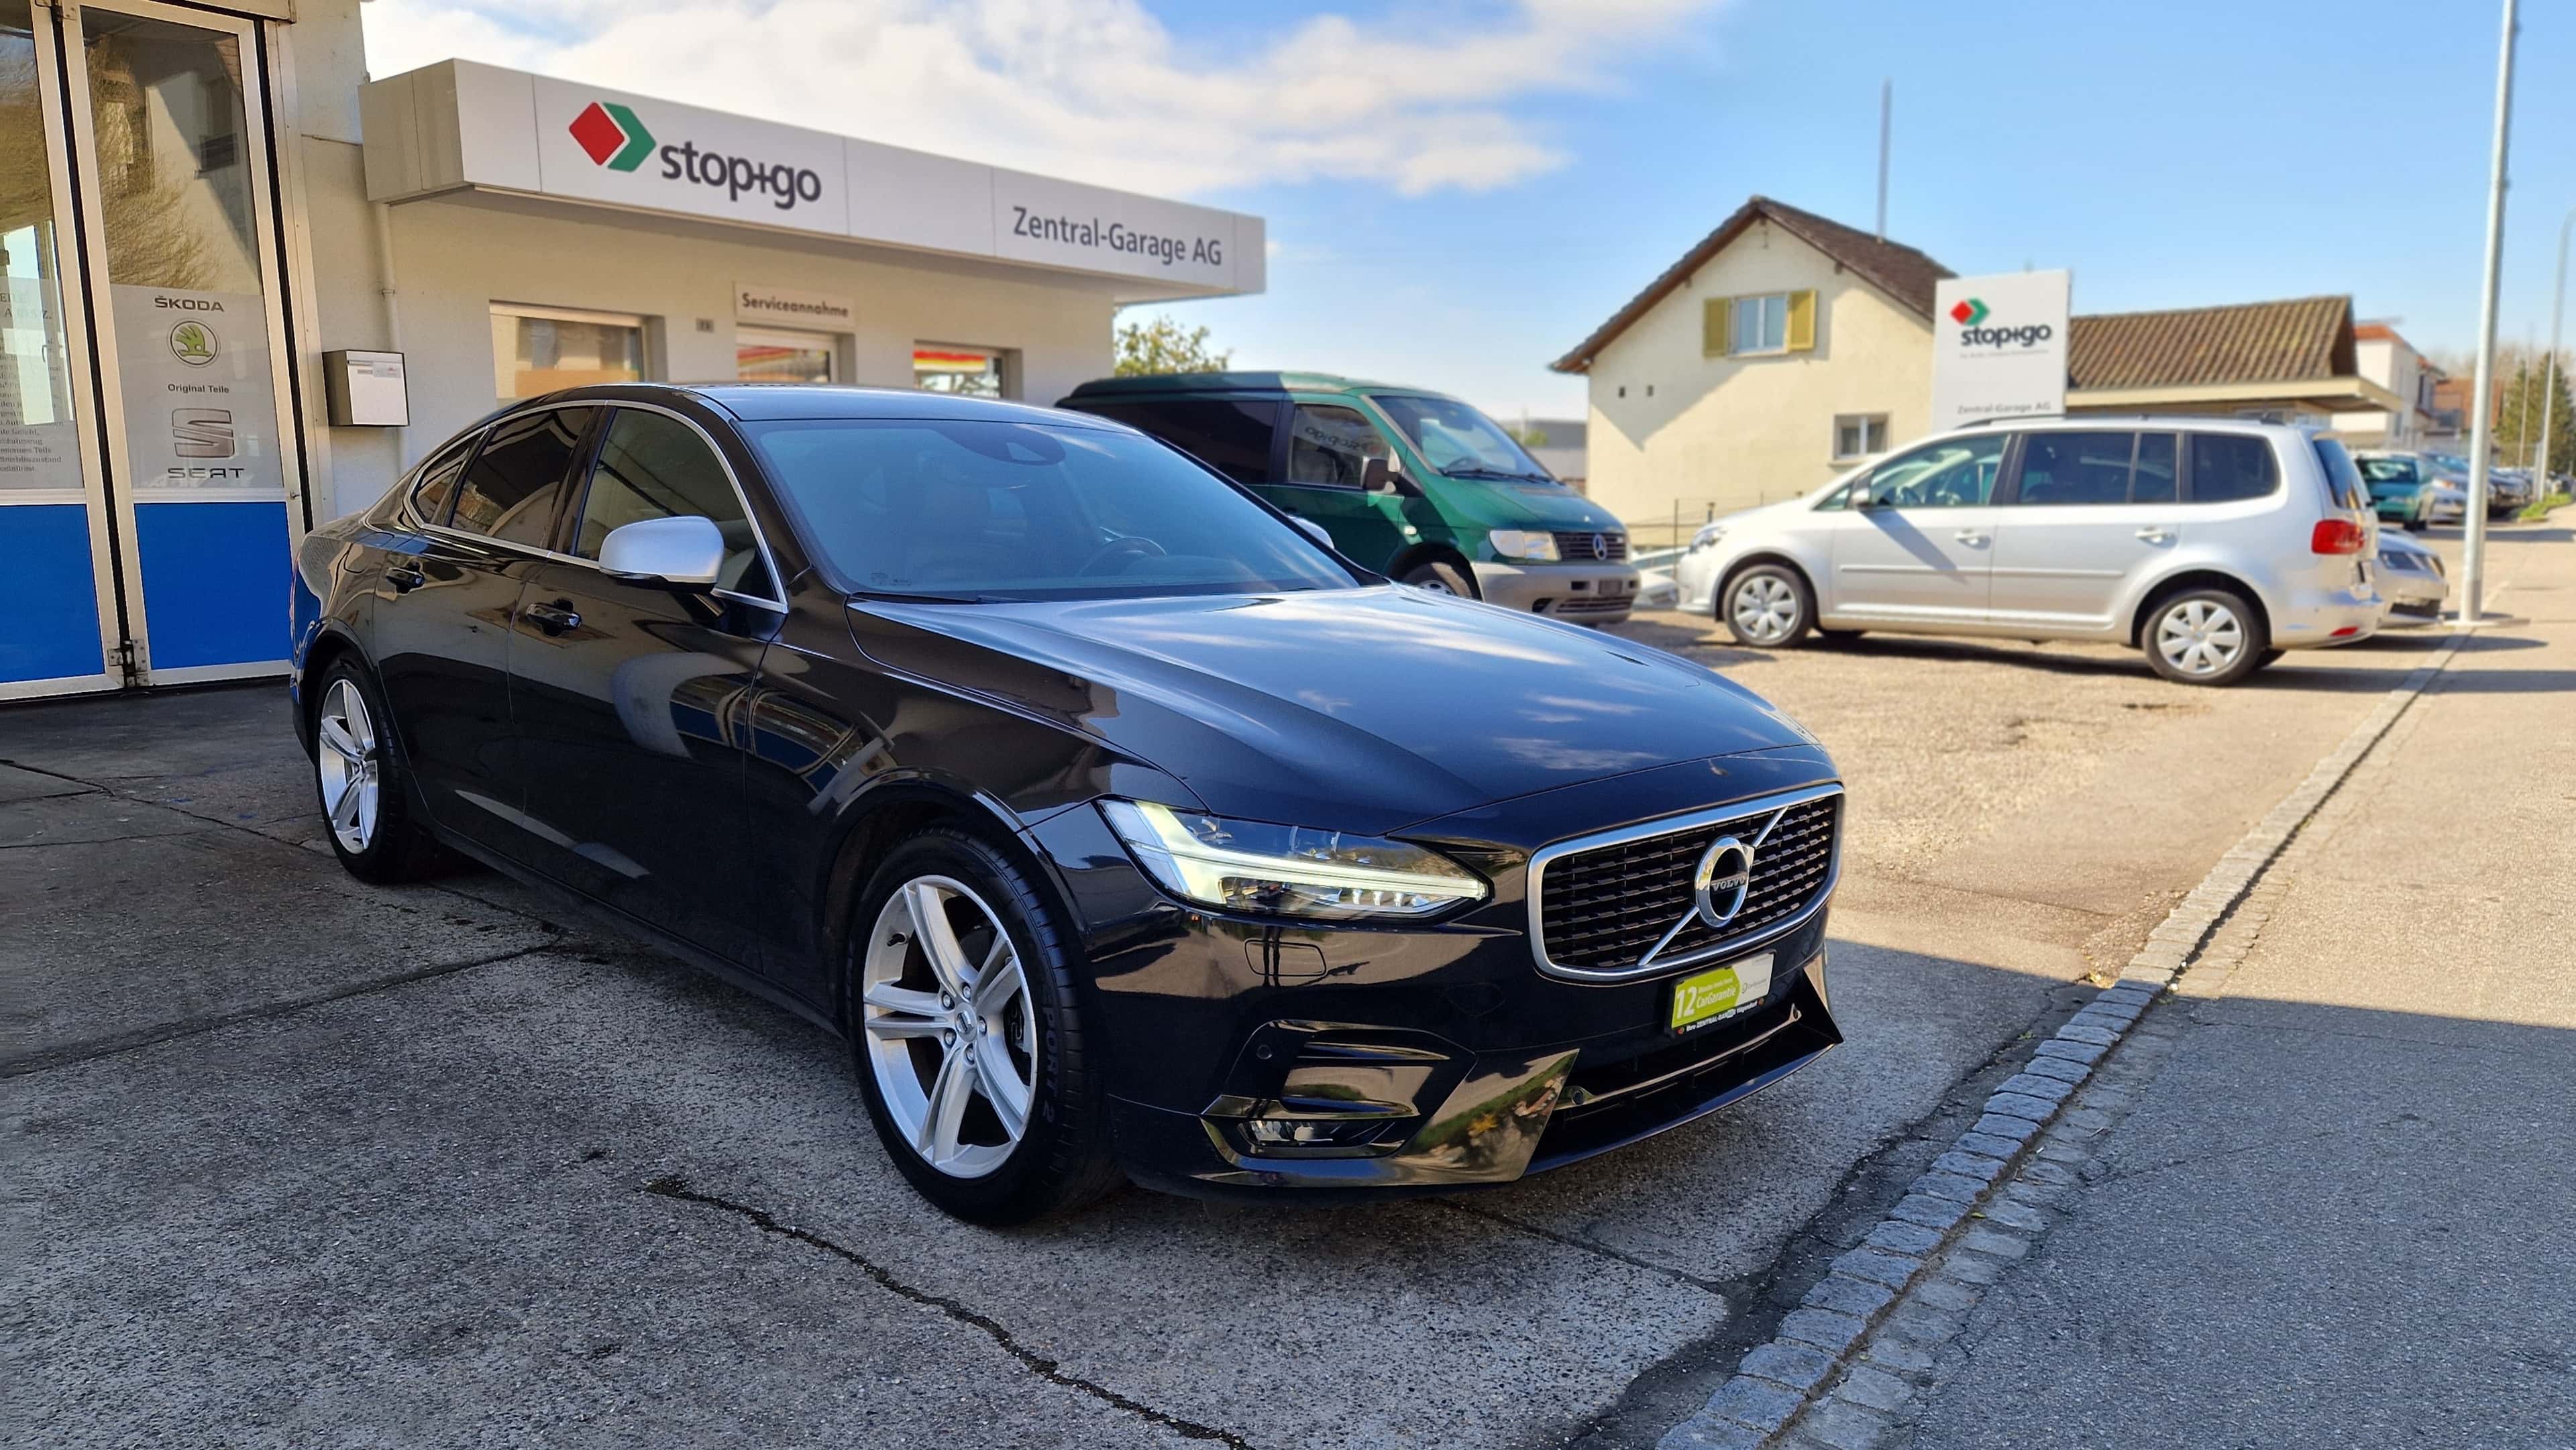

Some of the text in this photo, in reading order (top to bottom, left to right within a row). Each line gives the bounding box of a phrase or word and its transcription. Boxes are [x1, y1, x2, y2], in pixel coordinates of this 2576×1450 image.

[660, 141, 821, 210] stop+go
[1013, 206, 1222, 266] Zentral-Garage AG
[154, 295, 225, 312] ŠKODA
[741, 292, 849, 317] Serviceannahme
[1961, 325, 2052, 349] stop+go
[168, 383, 229, 394] Original Teile
[168, 467, 245, 478] SEAT
[1711, 875, 1746, 891] VOLVO
[1676, 986, 1698, 1019] 12
[1697, 985, 1737, 1009] CarGarantie
